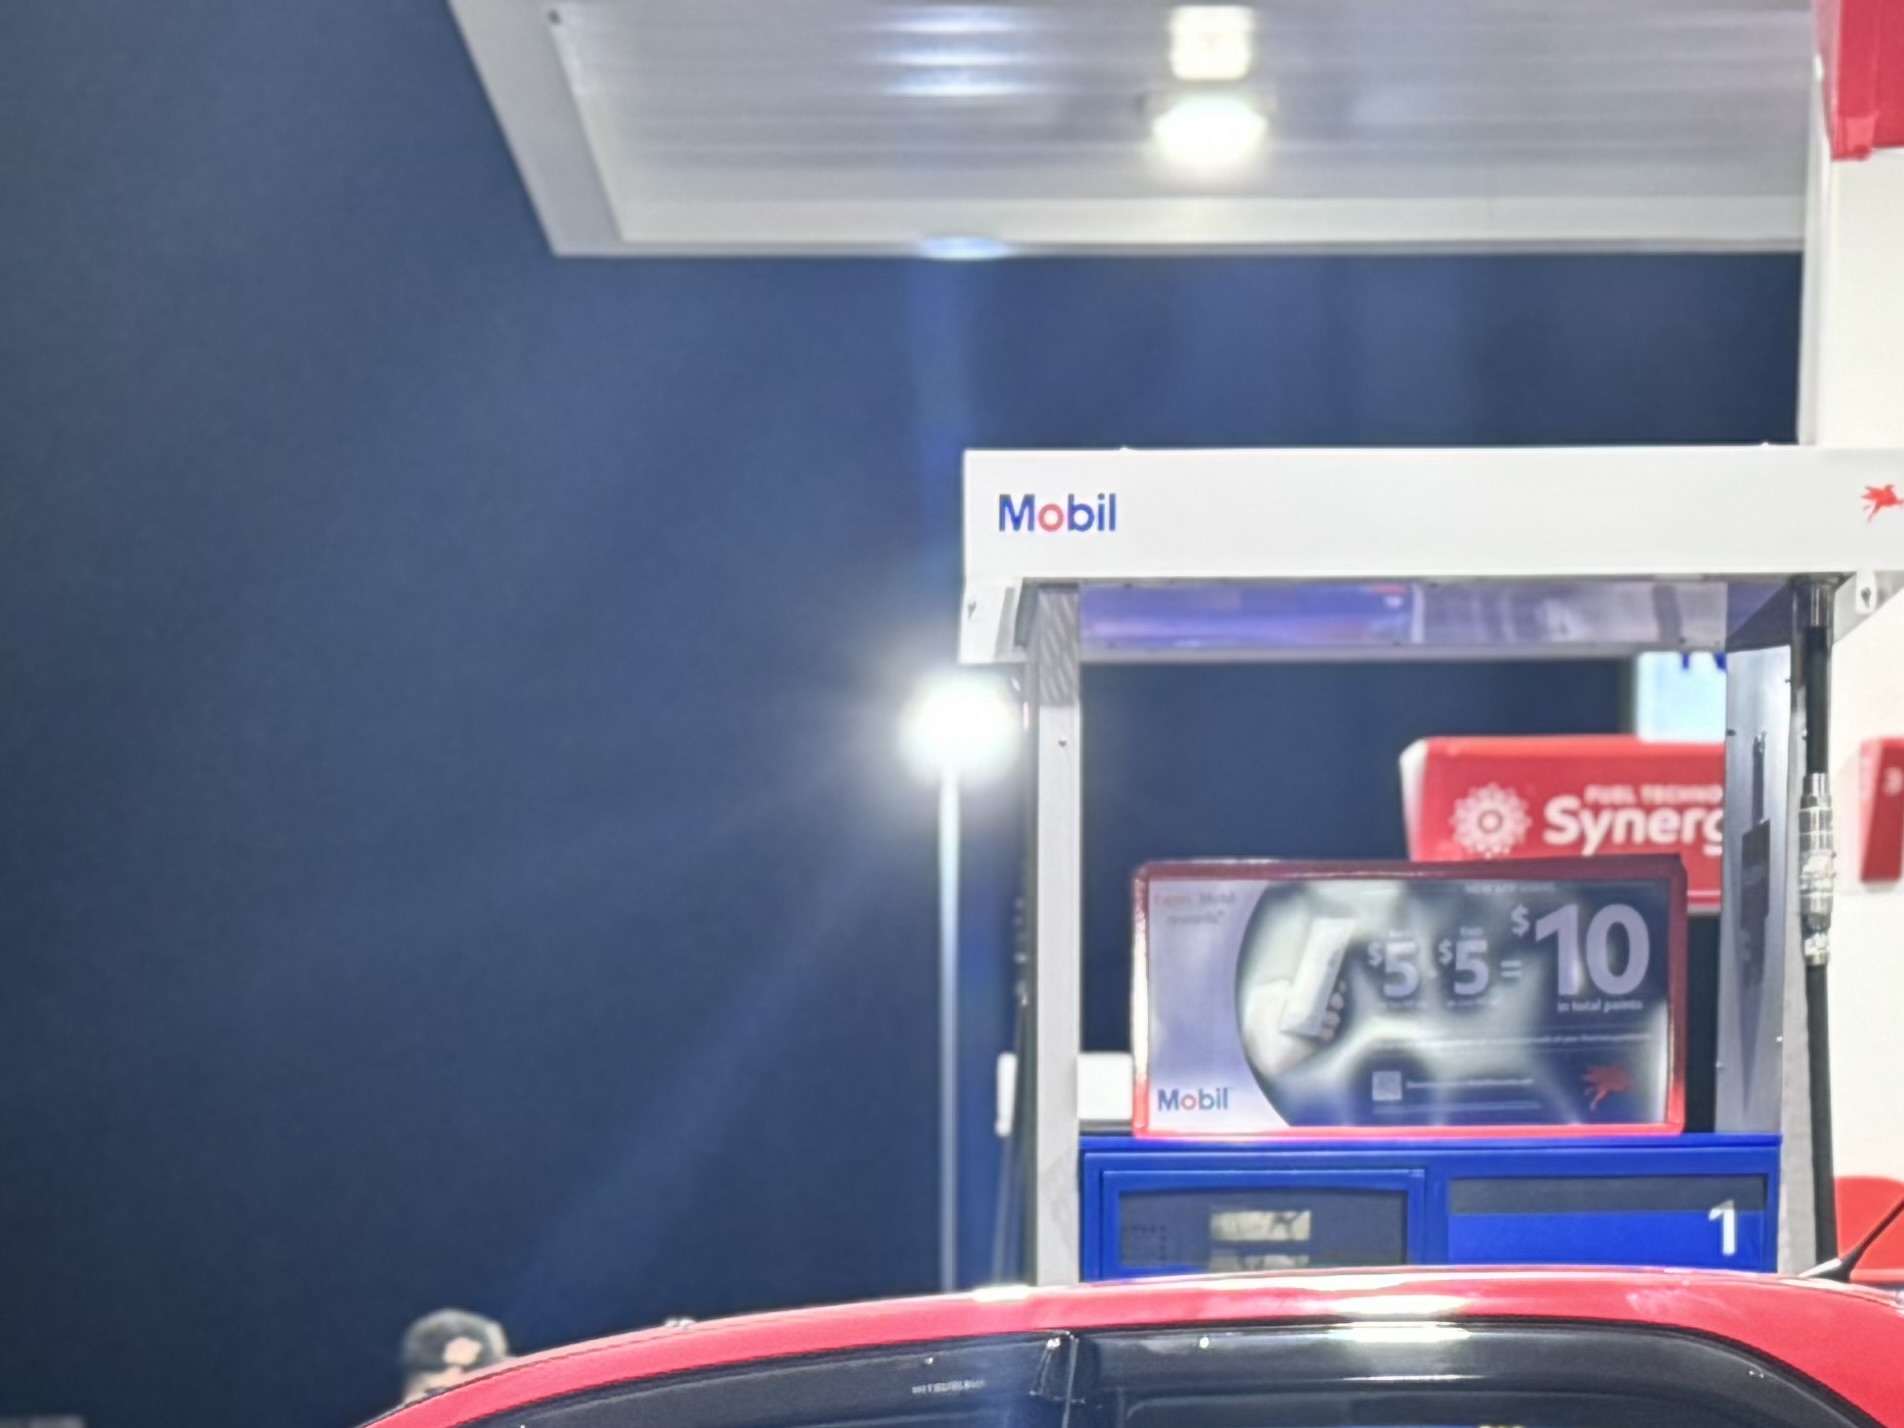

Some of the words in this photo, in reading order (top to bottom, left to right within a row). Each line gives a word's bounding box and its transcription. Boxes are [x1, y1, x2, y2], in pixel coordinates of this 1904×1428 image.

[998, 492, 1117, 532] Mobil
[1543, 794, 1724, 857] Synerg
[1510, 903, 1650, 996] $10
[1157, 1087, 1229, 1112] Mobil
[1708, 1199, 1736, 1256] 1
